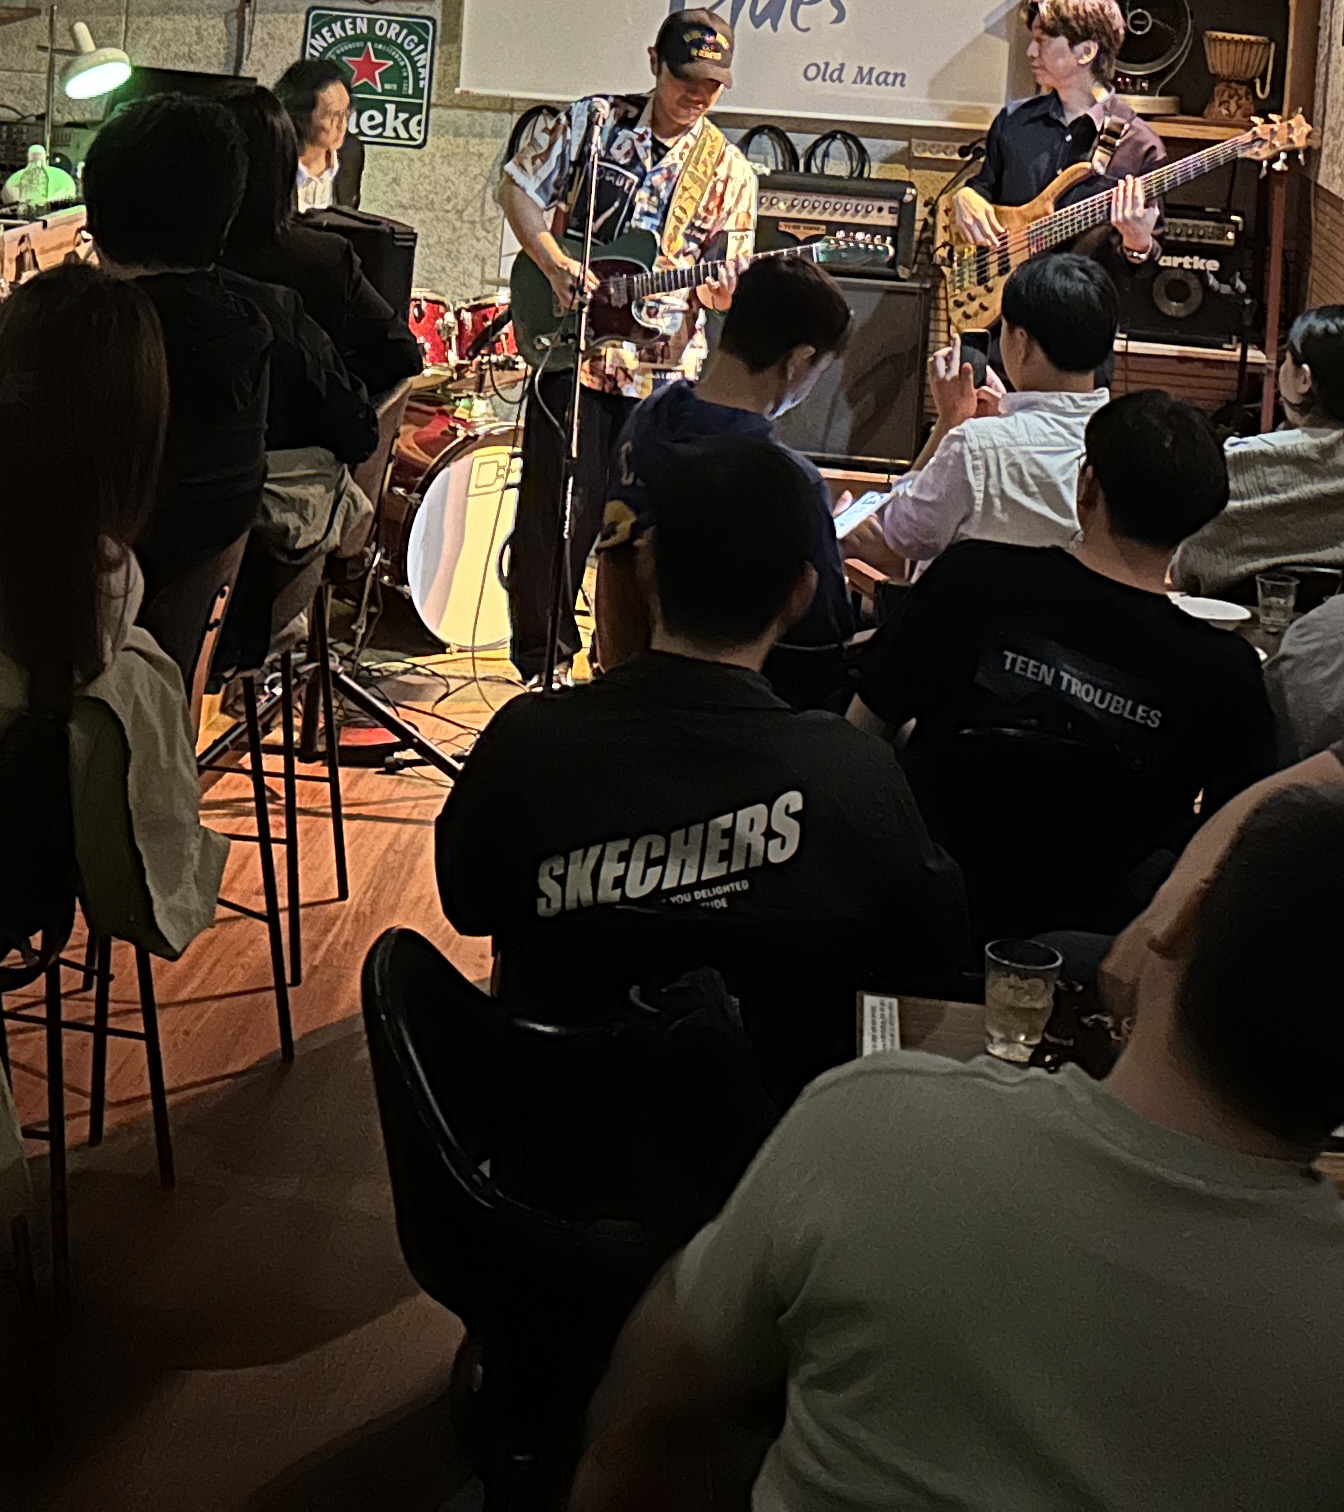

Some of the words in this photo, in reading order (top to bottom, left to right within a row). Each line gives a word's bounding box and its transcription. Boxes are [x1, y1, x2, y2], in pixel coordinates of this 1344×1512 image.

[803, 62, 845, 84] Old
[852, 66, 907, 88] Man
[1003, 650, 1055, 686] TEEN
[1059, 671, 1162, 728] TROUBLES
[537, 790, 804, 917] SKECHERS
[694, 880, 750, 901] DELIGHTED
